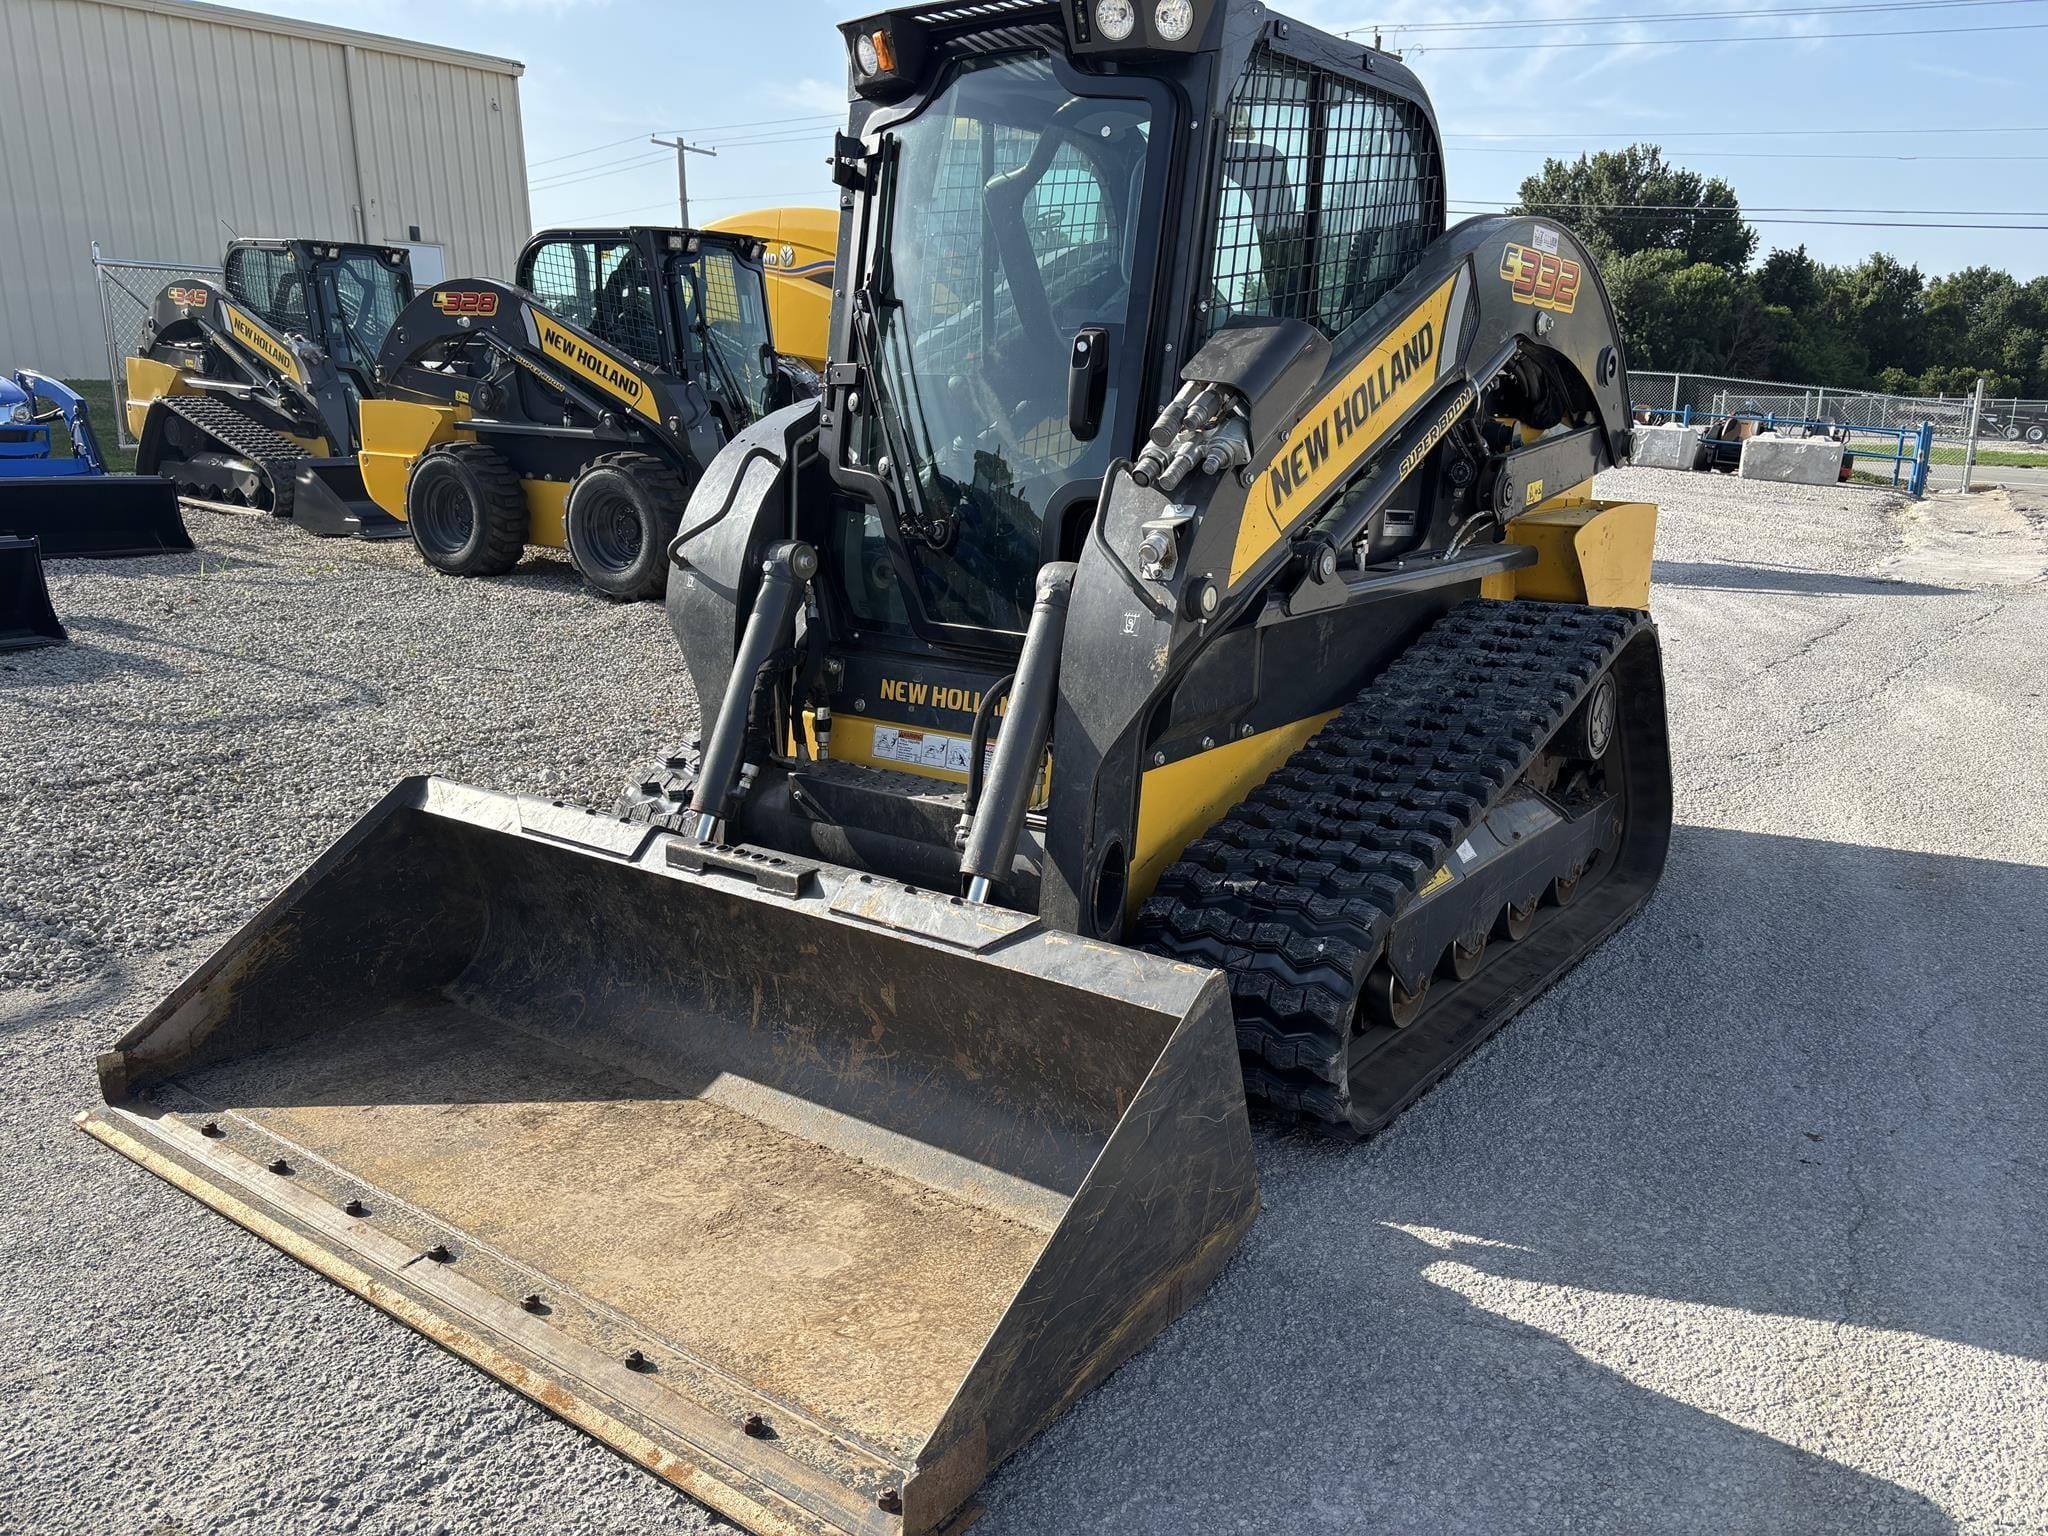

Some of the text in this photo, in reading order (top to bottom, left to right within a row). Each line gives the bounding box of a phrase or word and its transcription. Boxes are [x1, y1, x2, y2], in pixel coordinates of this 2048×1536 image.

[433, 292, 498, 316] L328
[1500, 243, 1580, 312] C332
[234, 318, 253, 339] NEW
[253, 332, 290, 368] HOLLAND
[544, 327, 640, 397] NEW HOLLAND
[1270, 321, 1433, 508] NEW HOLLAND
[1399, 424, 1439, 480] SUPER
[1438, 387, 1472, 435] BOOM
[880, 678, 1008, 717] NEW HOLL
